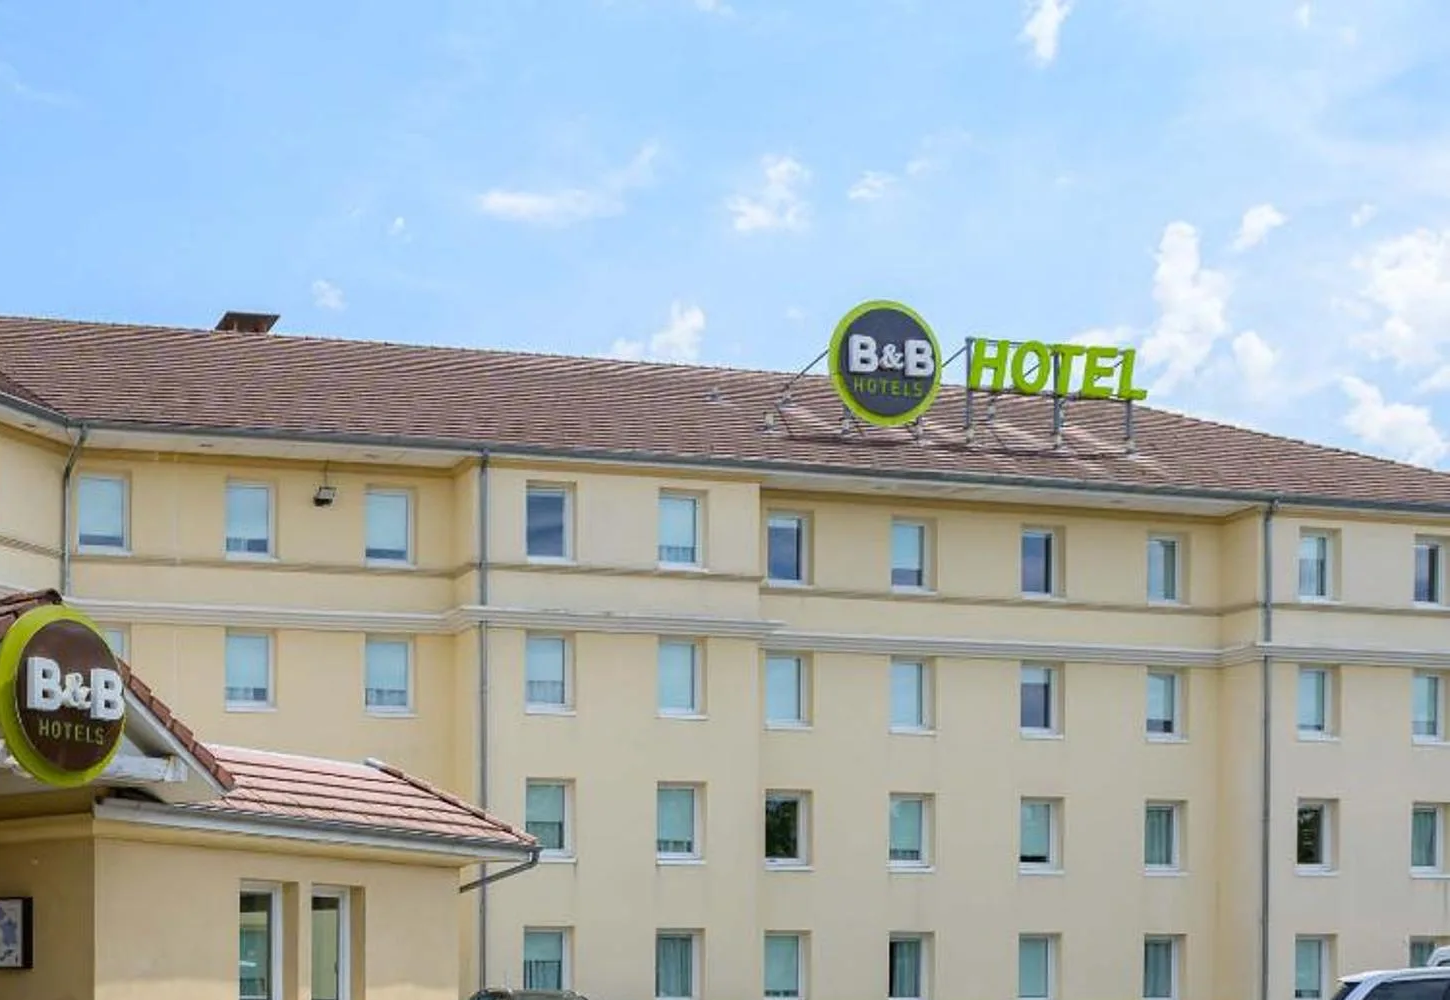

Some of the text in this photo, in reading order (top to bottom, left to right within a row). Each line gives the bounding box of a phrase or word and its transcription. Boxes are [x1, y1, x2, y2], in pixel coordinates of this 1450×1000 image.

[849, 334, 934, 377] B&B
[969, 338, 1148, 400] HOTEL
[854, 377, 923, 397] HOTELS
[26, 656, 125, 721] B&B
[38, 719, 105, 745] HOTELS
